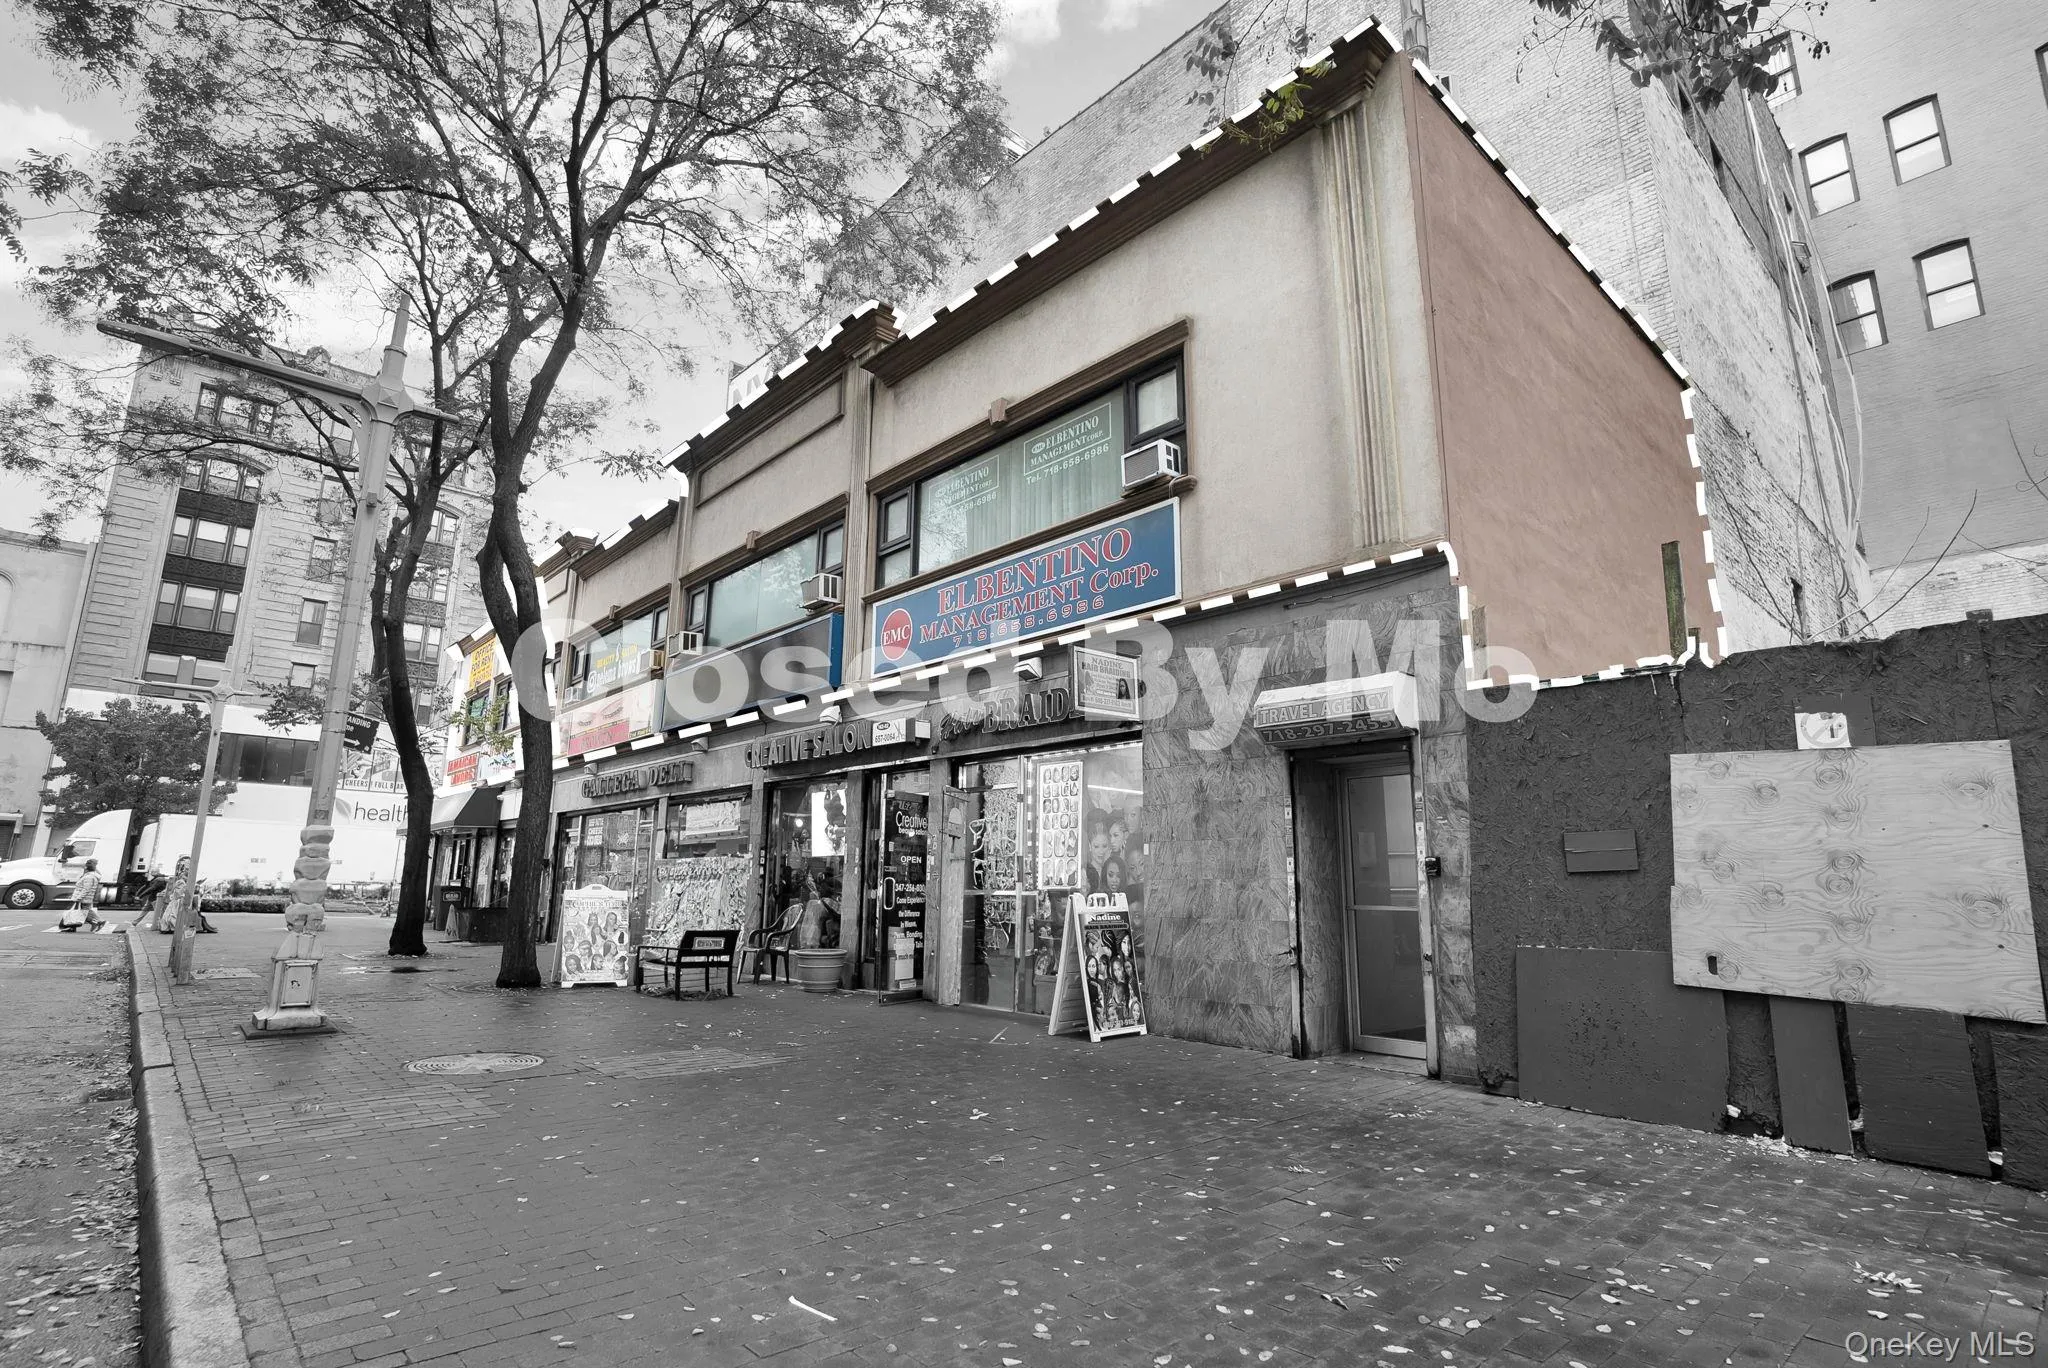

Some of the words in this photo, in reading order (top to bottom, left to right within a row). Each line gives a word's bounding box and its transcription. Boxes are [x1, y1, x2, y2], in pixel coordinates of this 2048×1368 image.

[1046, 415, 1099, 449] ELBENTINO
[1030, 434, 1087, 467] MANAGEMENT
[1043, 442, 1109, 478] 718-658-6986
[937, 527, 1132, 617] ELBENTINO
[919, 576, 1084, 644] MANAGEMENT
[1090, 561, 1159, 594] Corp.
[882, 623, 911, 646] EMC
[952, 595, 1105, 648] 718.658.6986
[1091, 656, 1124, 669] NADINE
[347, 714, 372, 729] ANDING
[981, 687, 1085, 734] BRAID
[1260, 702, 1318, 724] TRAVEL
[1321, 691, 1389, 720] AGENCY
[744, 732, 811, 769] CREATIVE
[812, 720, 872, 759] SALON
[344, 780, 369, 788] CHEERS
[374, 781, 388, 789] FULL
[650, 760, 693, 787] DELI
[895, 810, 928, 829] Creative
[900, 855, 922, 864] OPEN
[1090, 913, 1121, 921] Nadine
